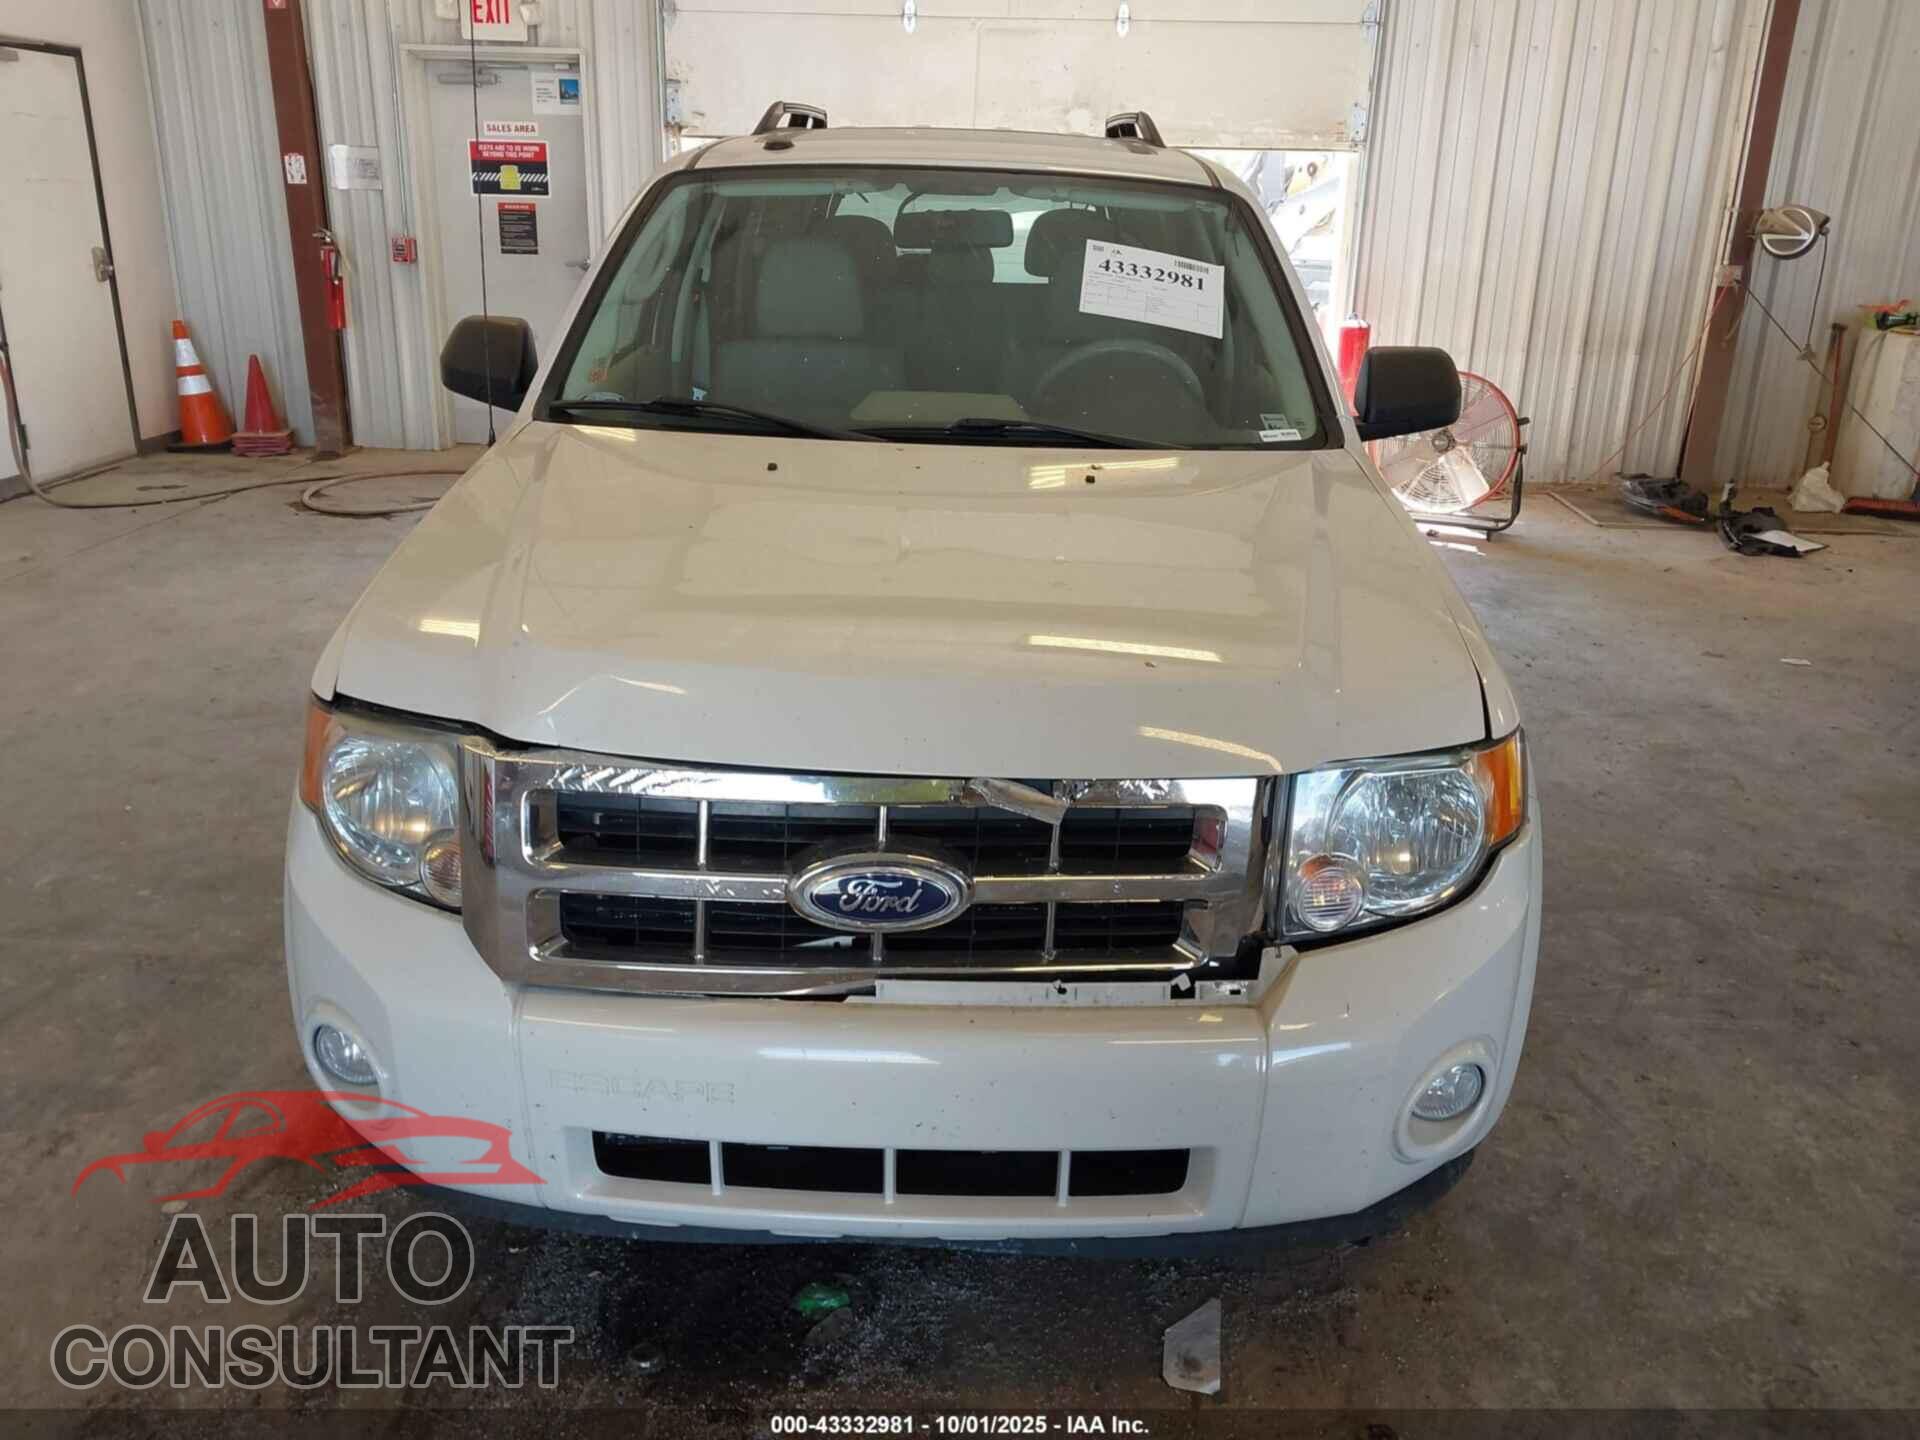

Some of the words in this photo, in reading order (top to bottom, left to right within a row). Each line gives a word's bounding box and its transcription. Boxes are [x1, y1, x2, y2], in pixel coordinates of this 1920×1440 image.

[486, 124, 512, 133] SALES
[514, 124, 536, 133] AREA
[1098, 258, 1205, 291] 43332981
[839, 878, 923, 913] Ford
